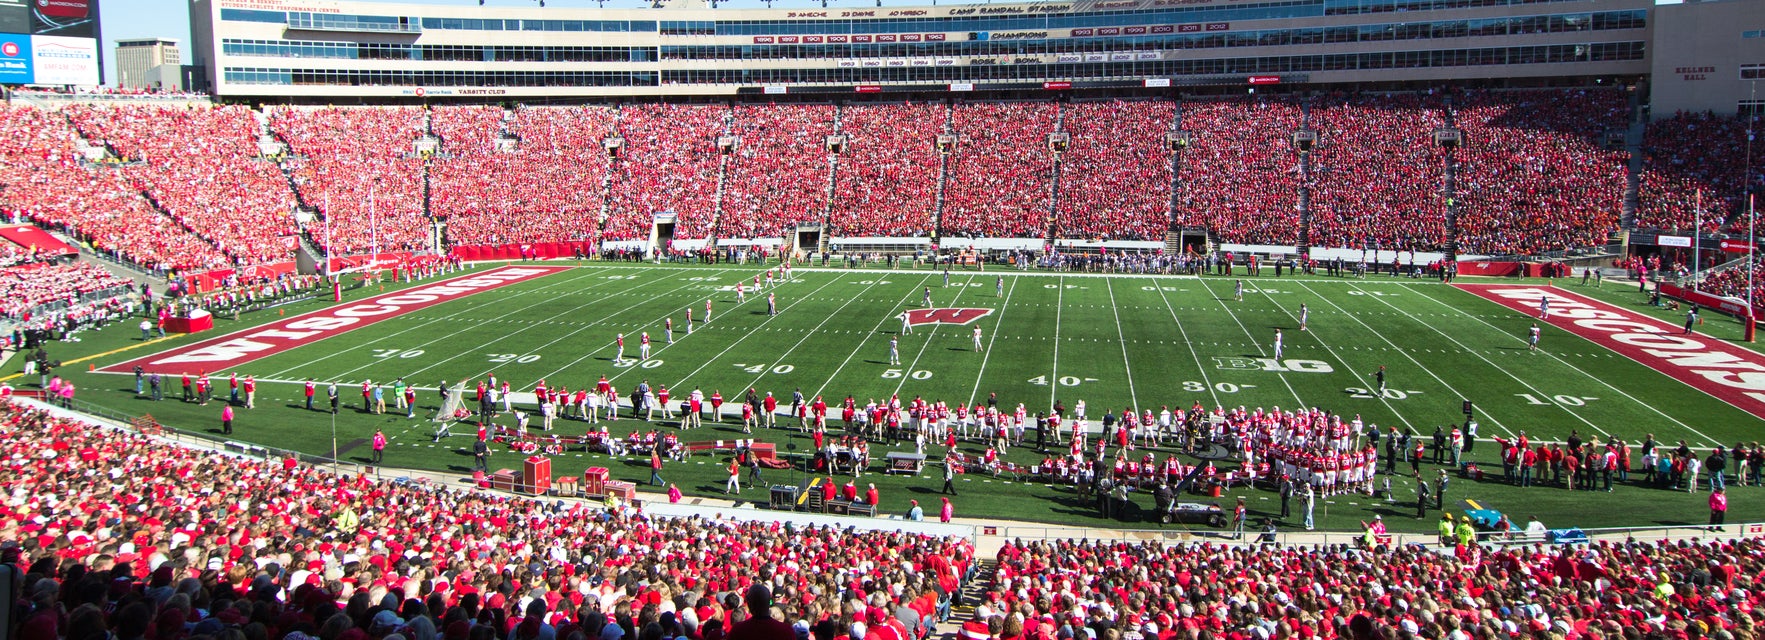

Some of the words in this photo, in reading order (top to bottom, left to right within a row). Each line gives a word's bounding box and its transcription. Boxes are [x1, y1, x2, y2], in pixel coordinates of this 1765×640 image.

[979, 6, 1024, 14] RANDALL
[1675, 66, 1715, 74] KELLNER
[149, 267, 551, 366] WISCONSIN
[378, 348, 425, 359] 10
[490, 353, 542, 364] 20
[743, 363, 795, 375] 40
[881, 368, 933, 380] 50
[1027, 375, 1081, 387] 40
[1182, 380, 1239, 394] 30
[1345, 387, 1407, 400] 20
[1514, 393, 1586, 407] 10
